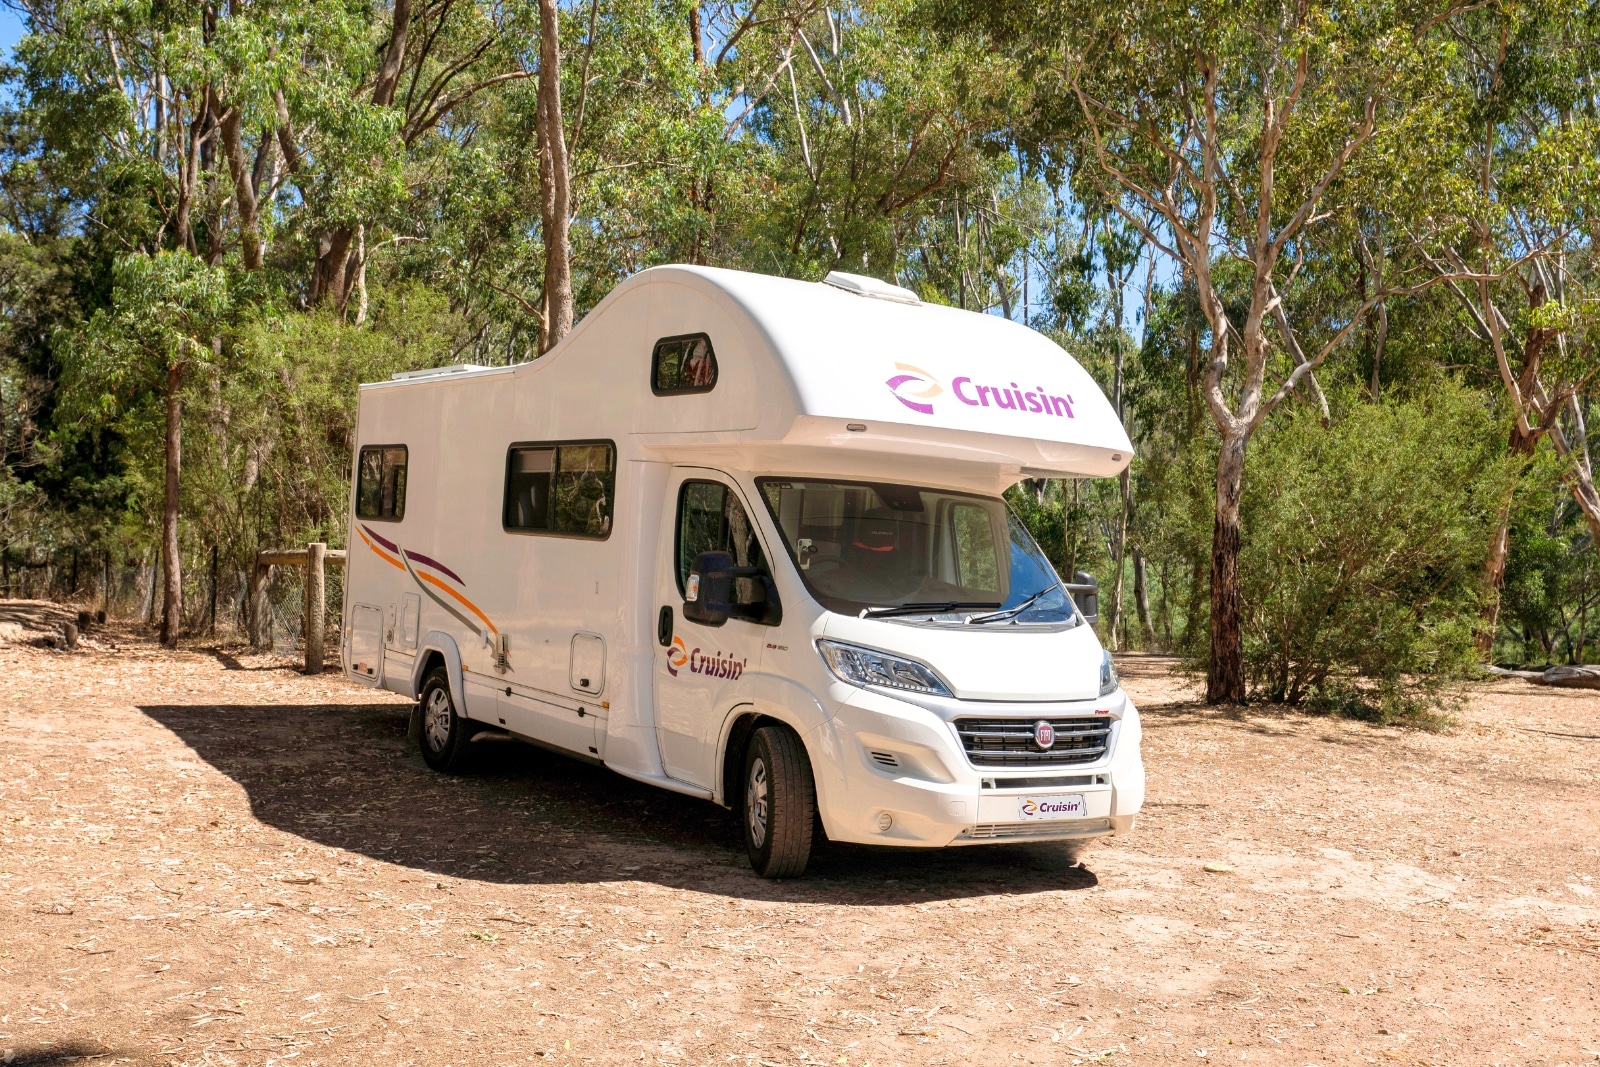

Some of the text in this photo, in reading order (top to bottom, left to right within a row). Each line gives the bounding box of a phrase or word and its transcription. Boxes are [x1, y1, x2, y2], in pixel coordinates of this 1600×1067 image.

[952, 376, 1075, 419] Cruisin'
[690, 648, 747, 680] Cruisin'
[1040, 729, 1051, 742] FIAT
[1039, 802, 1080, 813] Cruisin'
